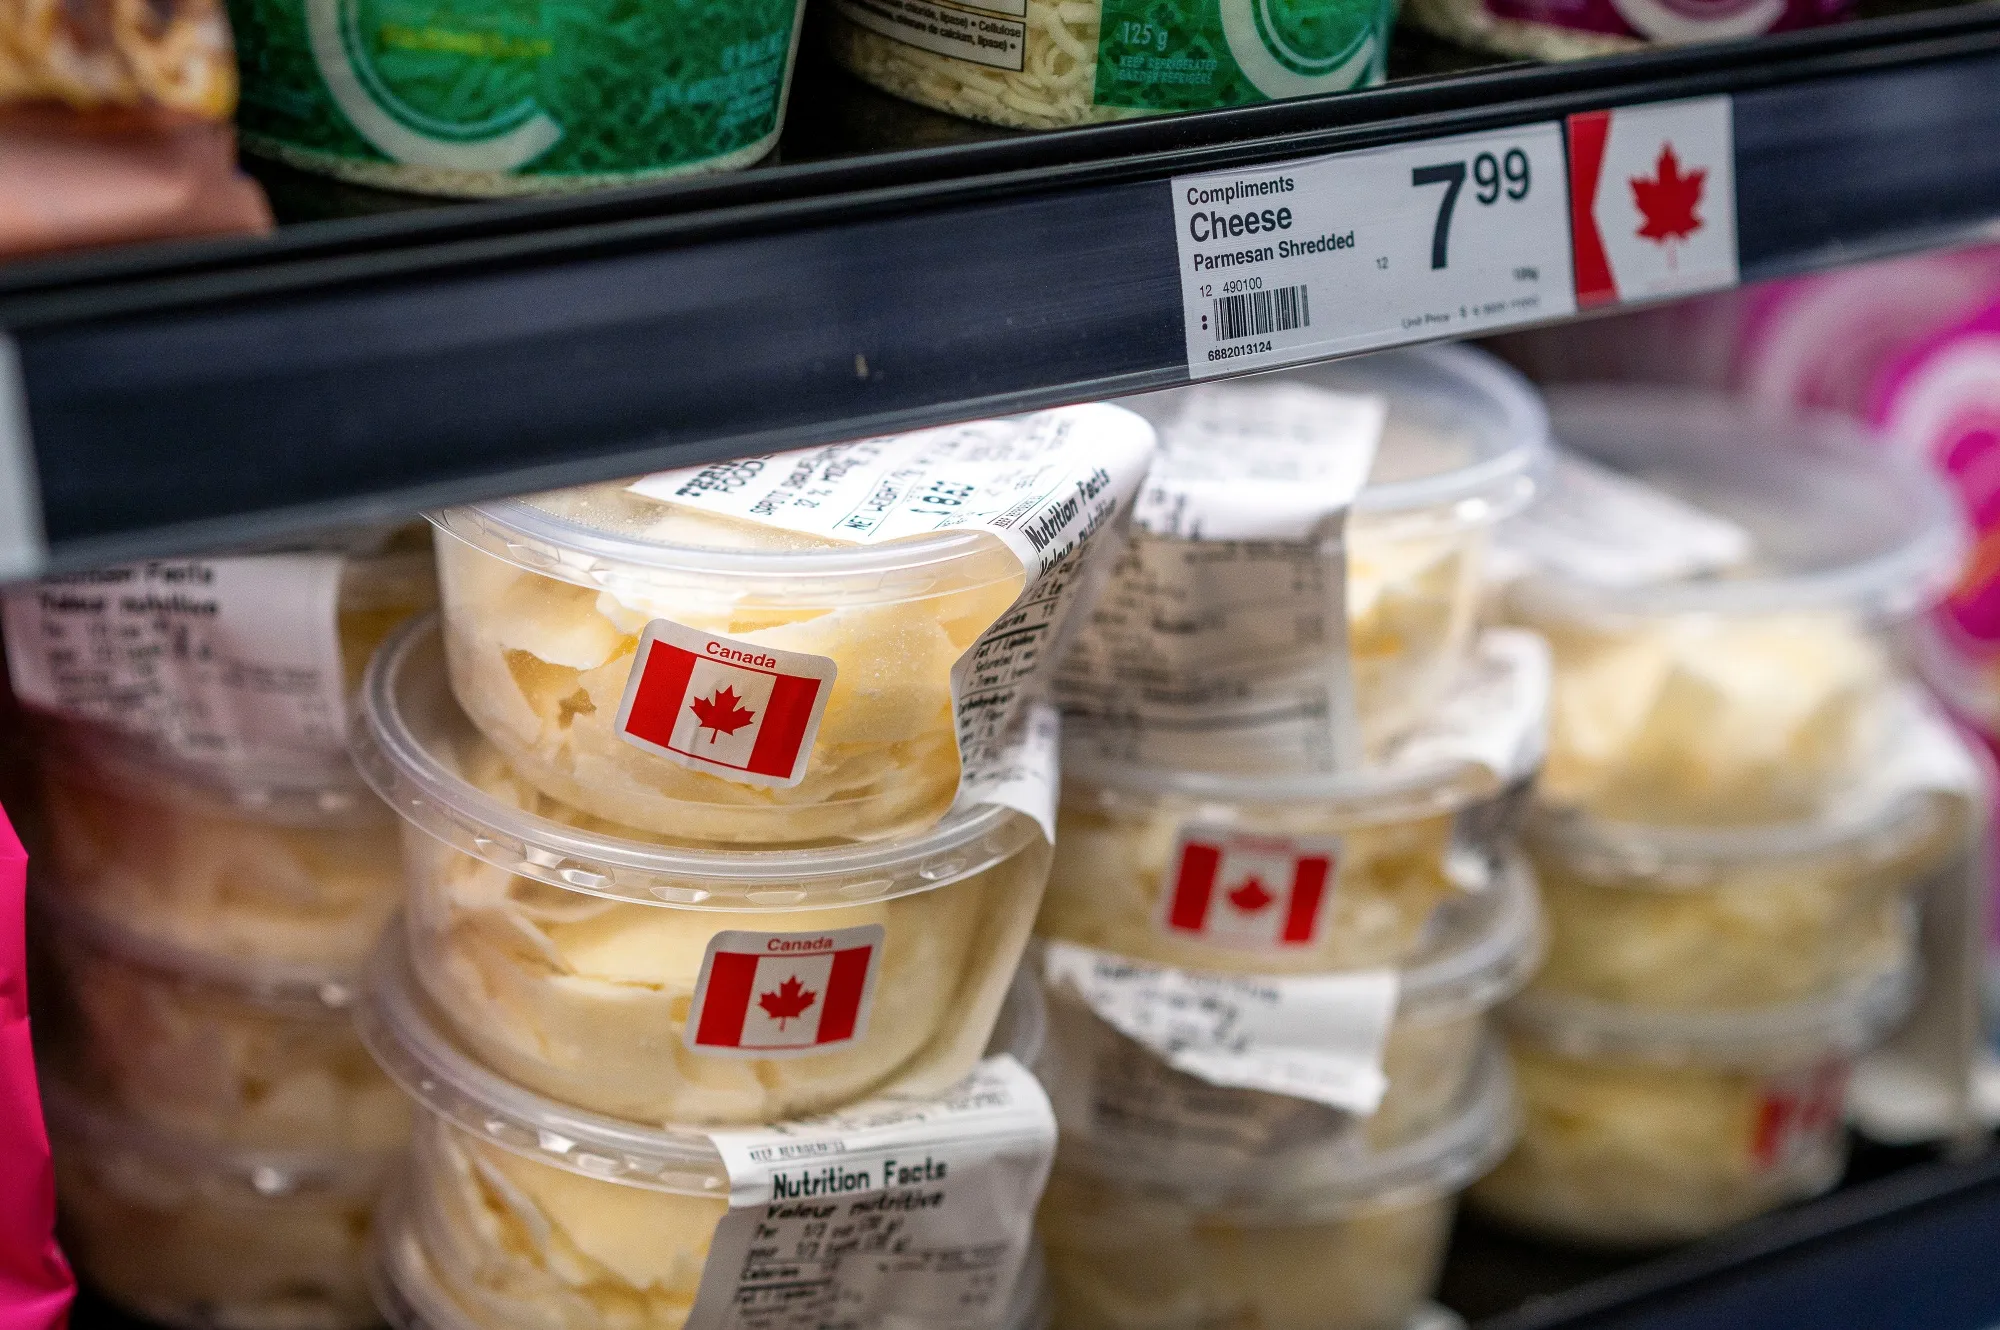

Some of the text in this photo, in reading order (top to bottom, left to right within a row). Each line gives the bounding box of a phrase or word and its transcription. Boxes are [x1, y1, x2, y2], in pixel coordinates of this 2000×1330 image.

[978, 20, 1022, 38] Cellulose
[1122, 21, 1169, 52] 125 g
[1187, 176, 1295, 205] Compliments
[1412, 146, 1532, 270] 7 99
[1190, 207, 1293, 243] Cheese
[1194, 230, 1355, 271] Parmesan Shredded
[1376, 256, 1390, 270] 12
[1200, 276, 1263, 298] 12 490100
[1208, 340, 1272, 362] 6882013124
[844, 514, 876, 531] NET
[1024, 497, 1079, 553] Nutrition
[1076, 467, 1111, 506] Facts
[706, 641, 777, 669] Canada
[767, 937, 833, 952] Canada
[773, 1156, 948, 1201] Nutrition Facts
